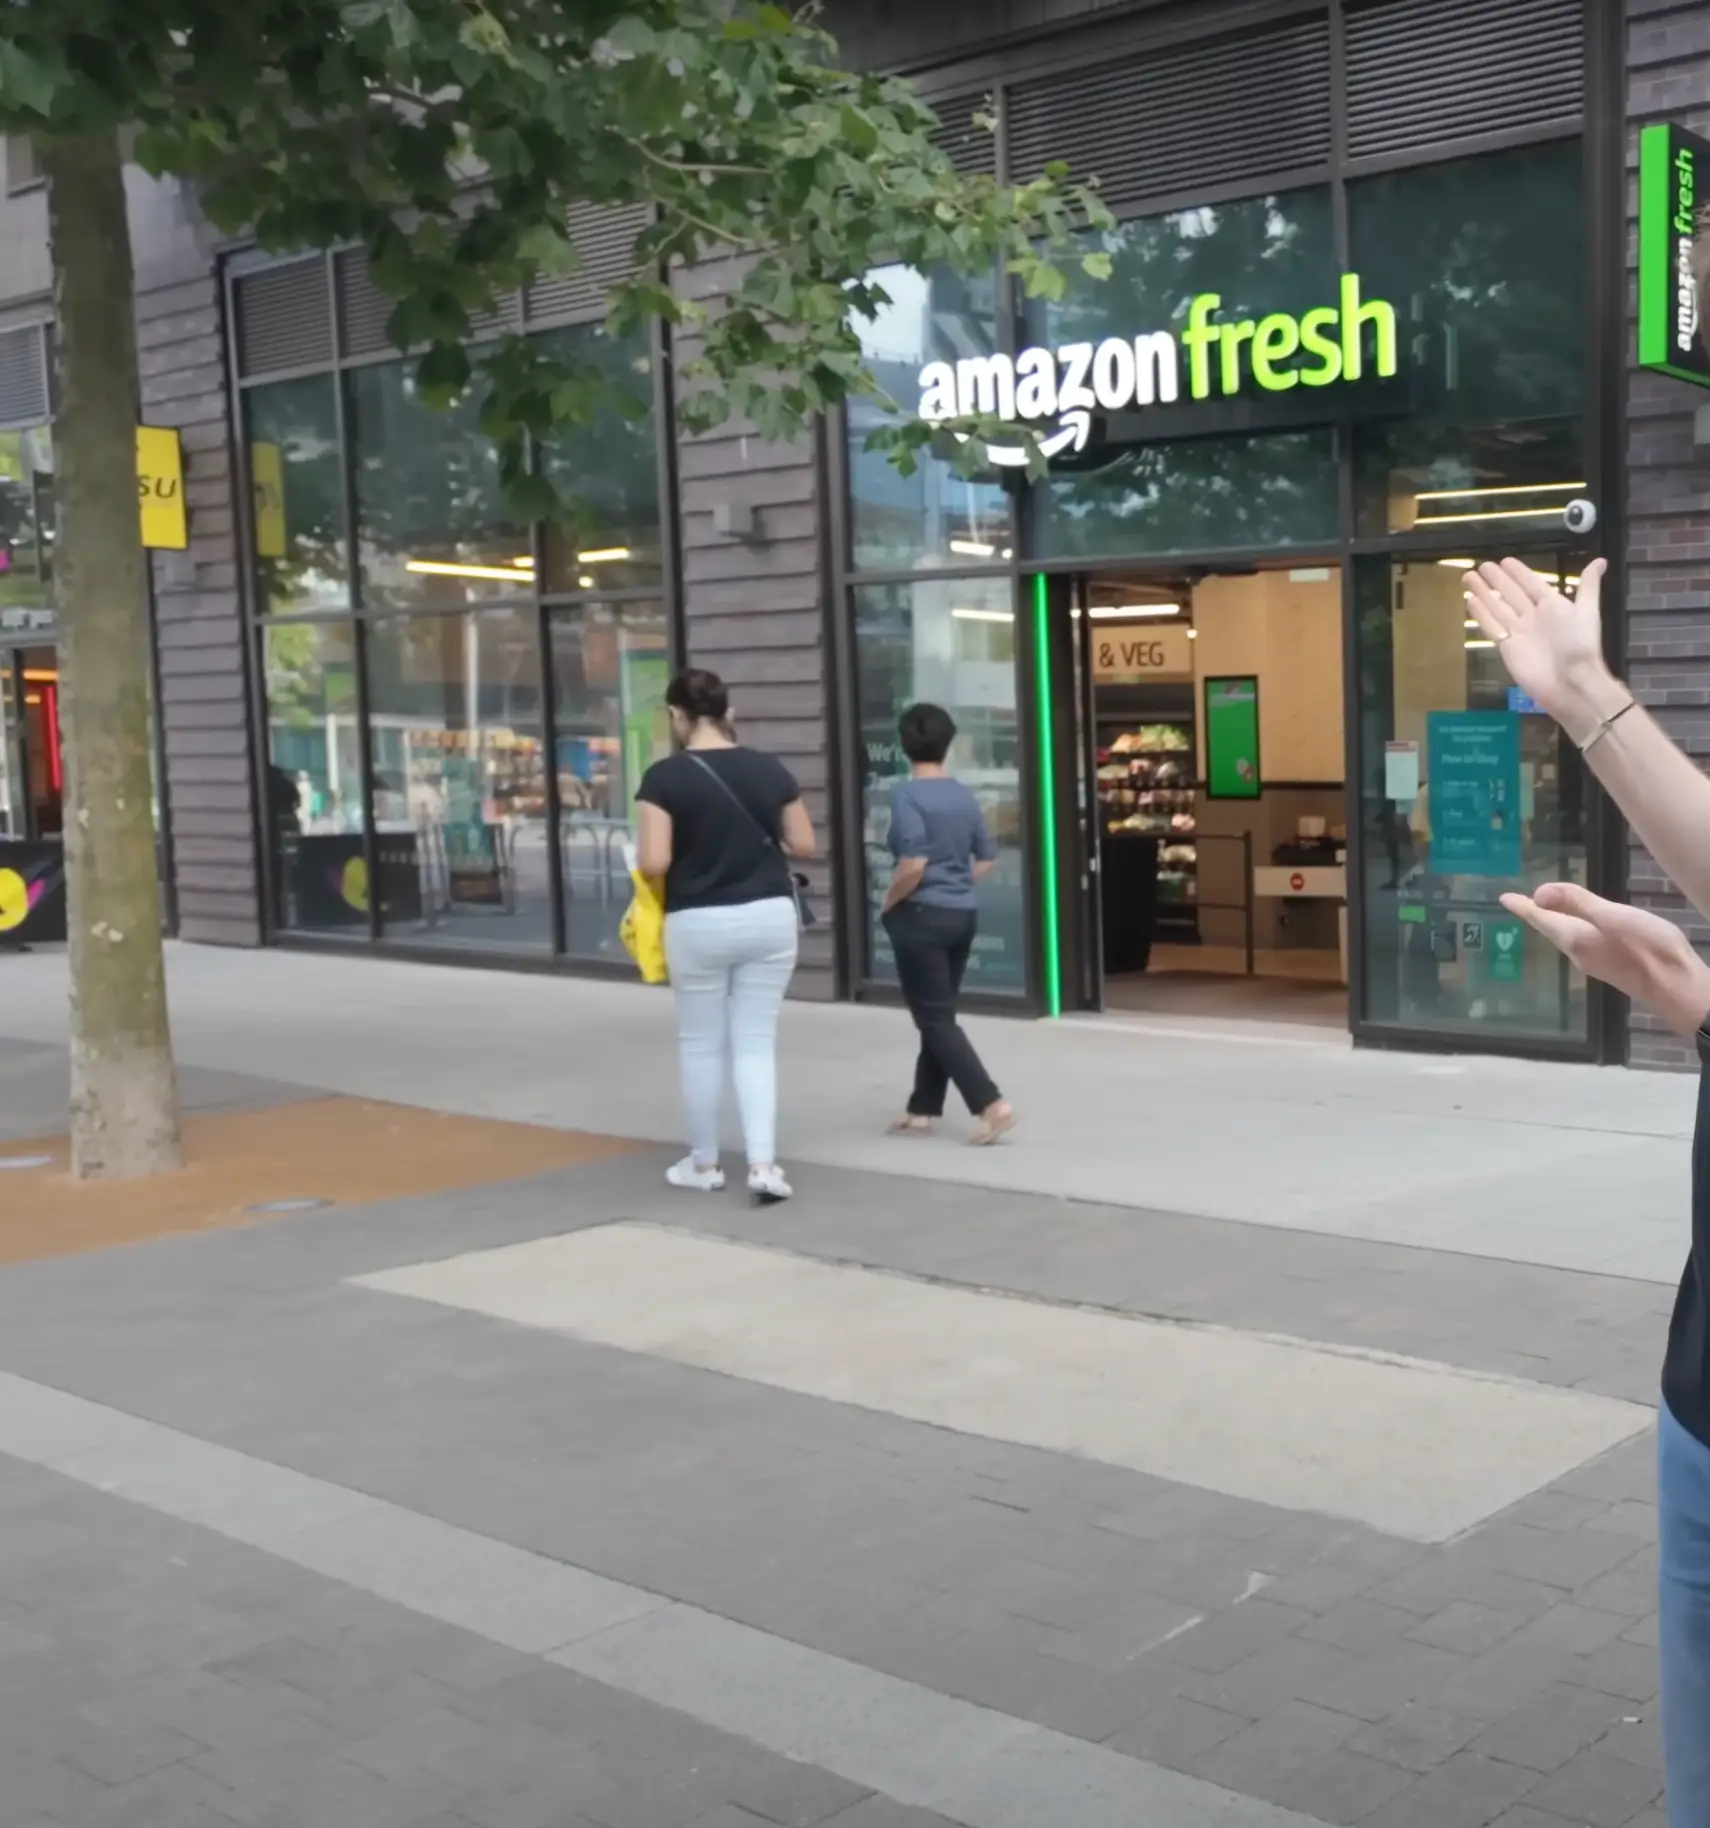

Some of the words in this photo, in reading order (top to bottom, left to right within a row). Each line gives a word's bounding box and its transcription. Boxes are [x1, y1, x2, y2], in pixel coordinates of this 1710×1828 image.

[1674, 148, 1694, 234] fresh
[1677, 237, 1696, 352] amazon
[918, 330, 1178, 422] amazon
[1181, 273, 1397, 399] fresh
[1098, 642, 1115, 668] &
[1120, 641, 1165, 667] VEG
